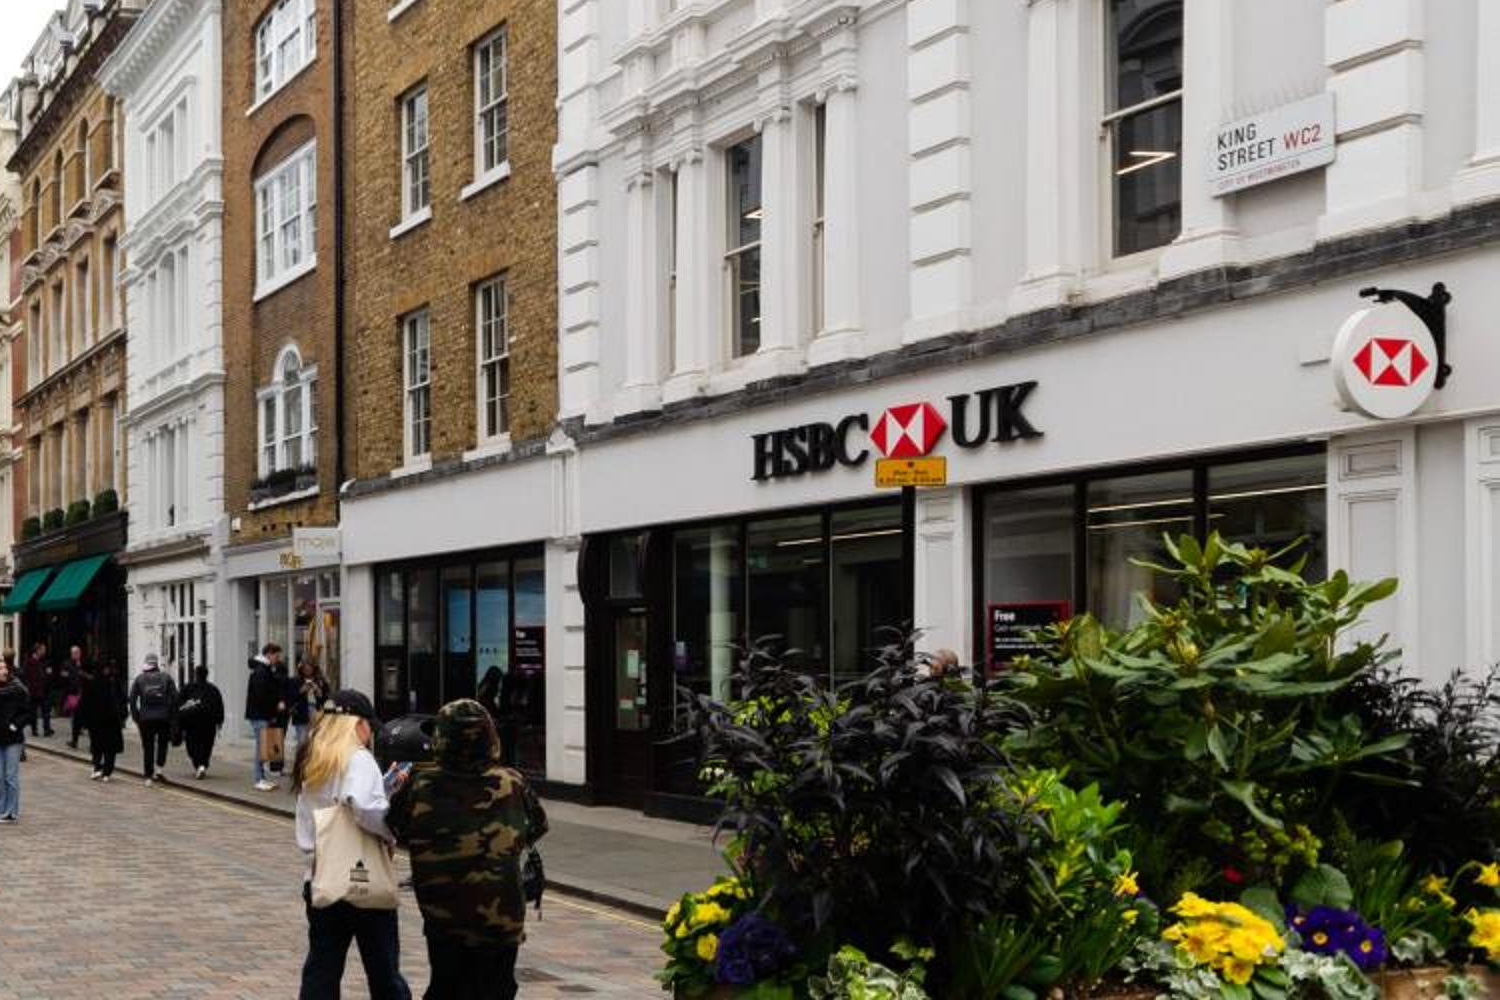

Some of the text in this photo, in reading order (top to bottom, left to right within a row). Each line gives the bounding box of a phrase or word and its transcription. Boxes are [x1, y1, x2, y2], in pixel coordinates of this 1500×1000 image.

[1217, 123, 1257, 151] KING
[1217, 124, 1321, 171] STREET WC2
[750, 381, 1045, 480] HSBC UK
[995, 610, 1016, 622] Free
